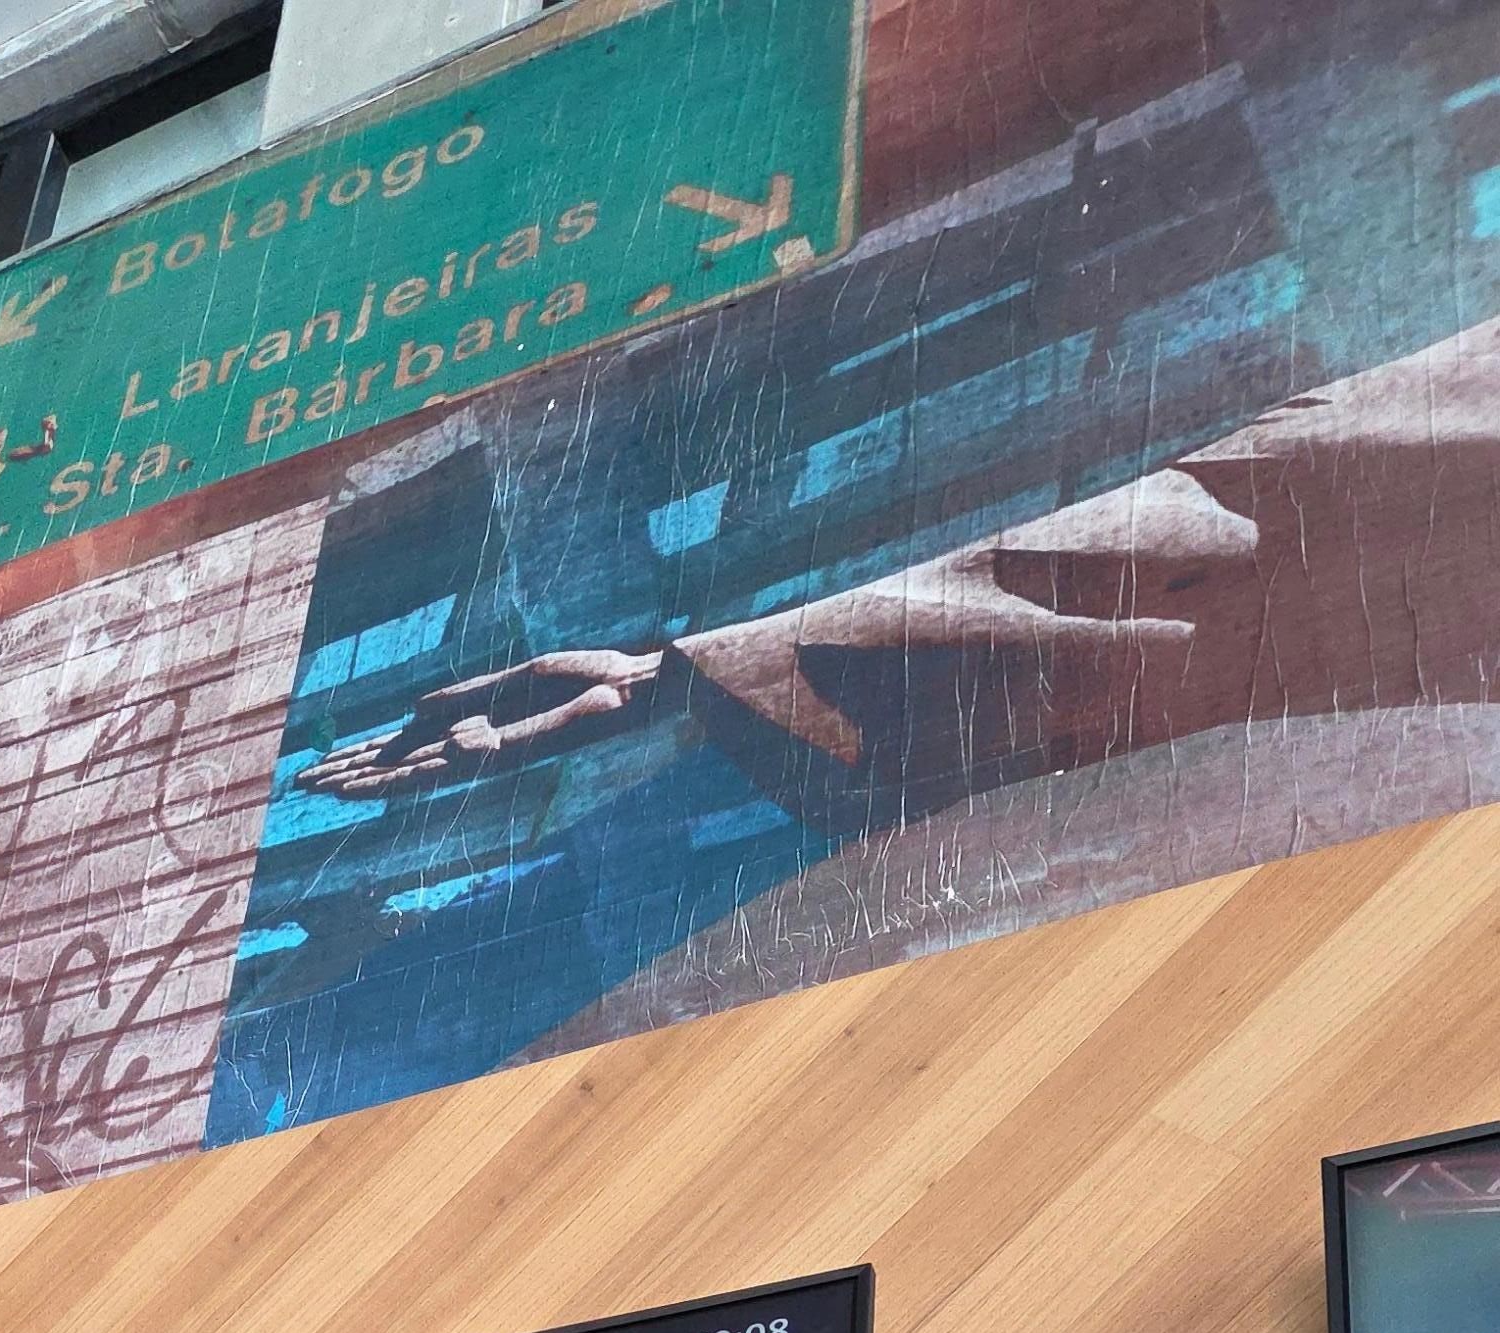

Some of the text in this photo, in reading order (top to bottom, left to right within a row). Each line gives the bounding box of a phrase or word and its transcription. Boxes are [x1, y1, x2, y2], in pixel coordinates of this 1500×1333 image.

[108, 124, 486, 297] Botafogo
[121, 200, 599, 420] Laranjeiras
[44, 442, 194, 515] Sta.
[244, 281, 588, 446] Bárbara
